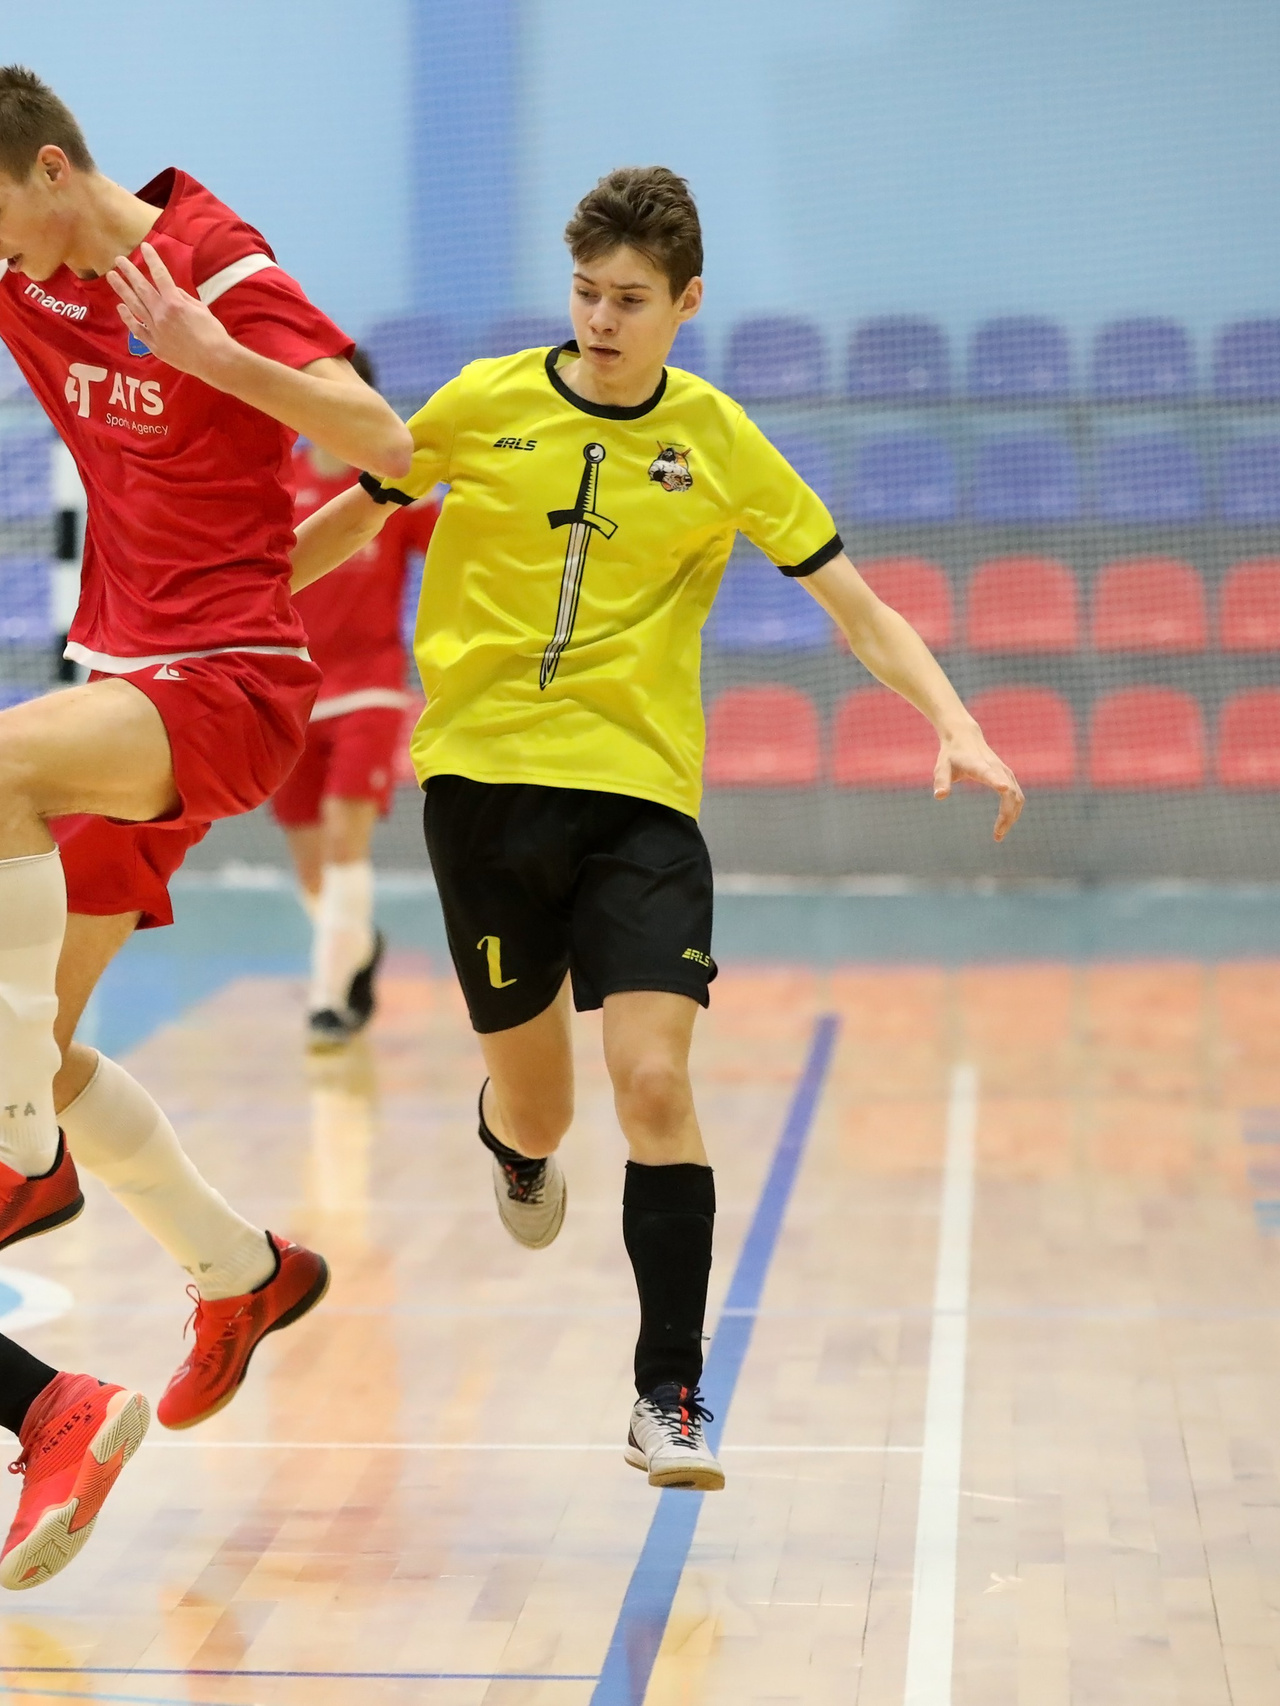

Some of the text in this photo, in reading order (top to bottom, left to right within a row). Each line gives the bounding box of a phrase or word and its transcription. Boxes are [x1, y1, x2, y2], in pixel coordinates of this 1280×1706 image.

[24, 282, 87, 320] macron
[108, 371, 165, 416] ATS
[131, 421, 169, 436] Agency
[493, 437, 538, 451] ERLS
[476, 935, 518, 989] 2
